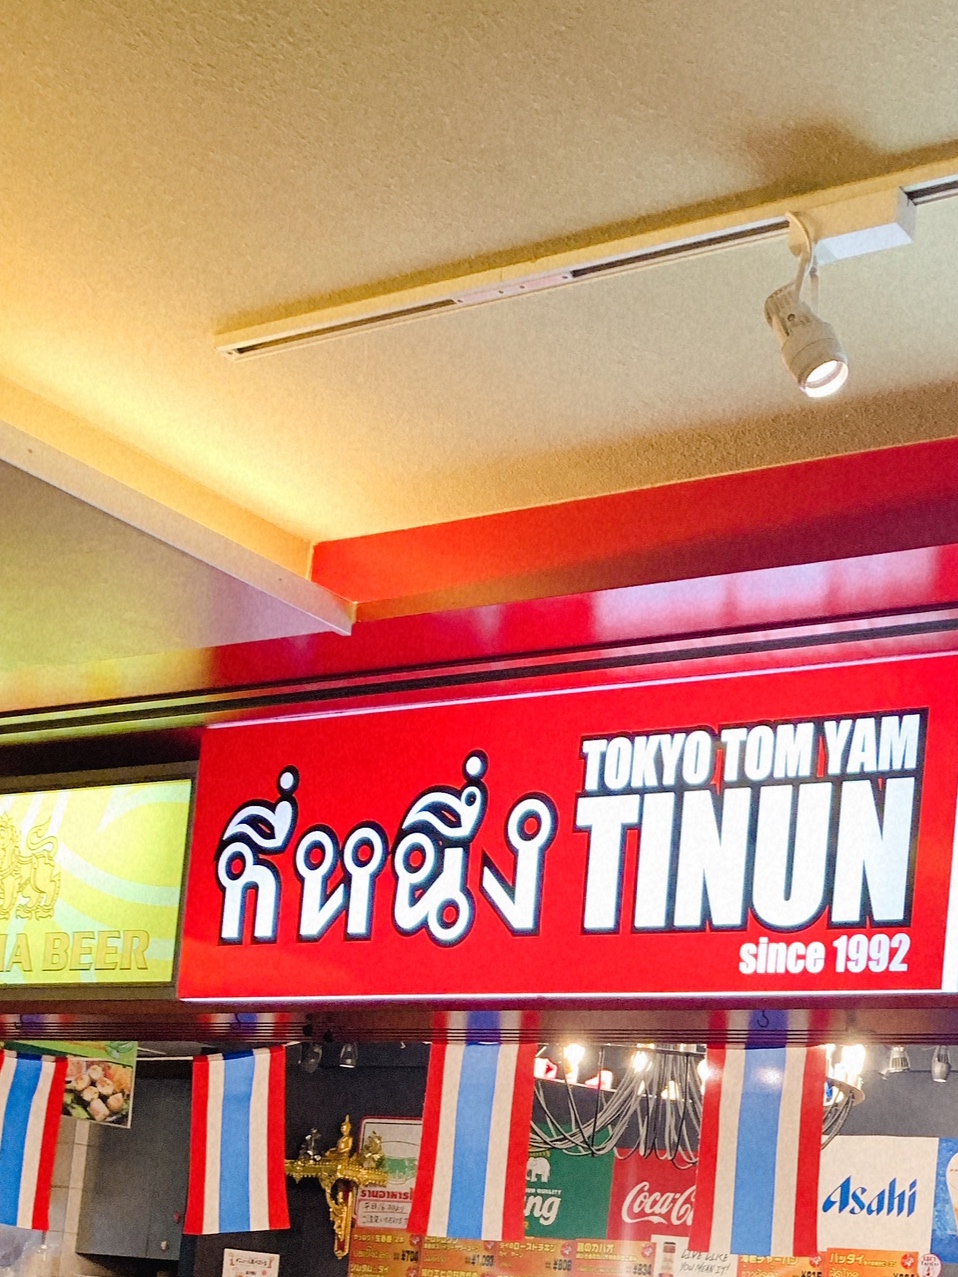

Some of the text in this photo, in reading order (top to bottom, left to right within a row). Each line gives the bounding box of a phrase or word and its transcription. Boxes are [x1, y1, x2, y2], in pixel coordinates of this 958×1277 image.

[582, 713, 921, 792] TOKYO TOM YAM
[575, 776, 916, 930] TINUN
[42, 928, 151, 972] BEER
[739, 932, 911, 975] since 1992
[821, 1175, 918, 1218] Asahi
